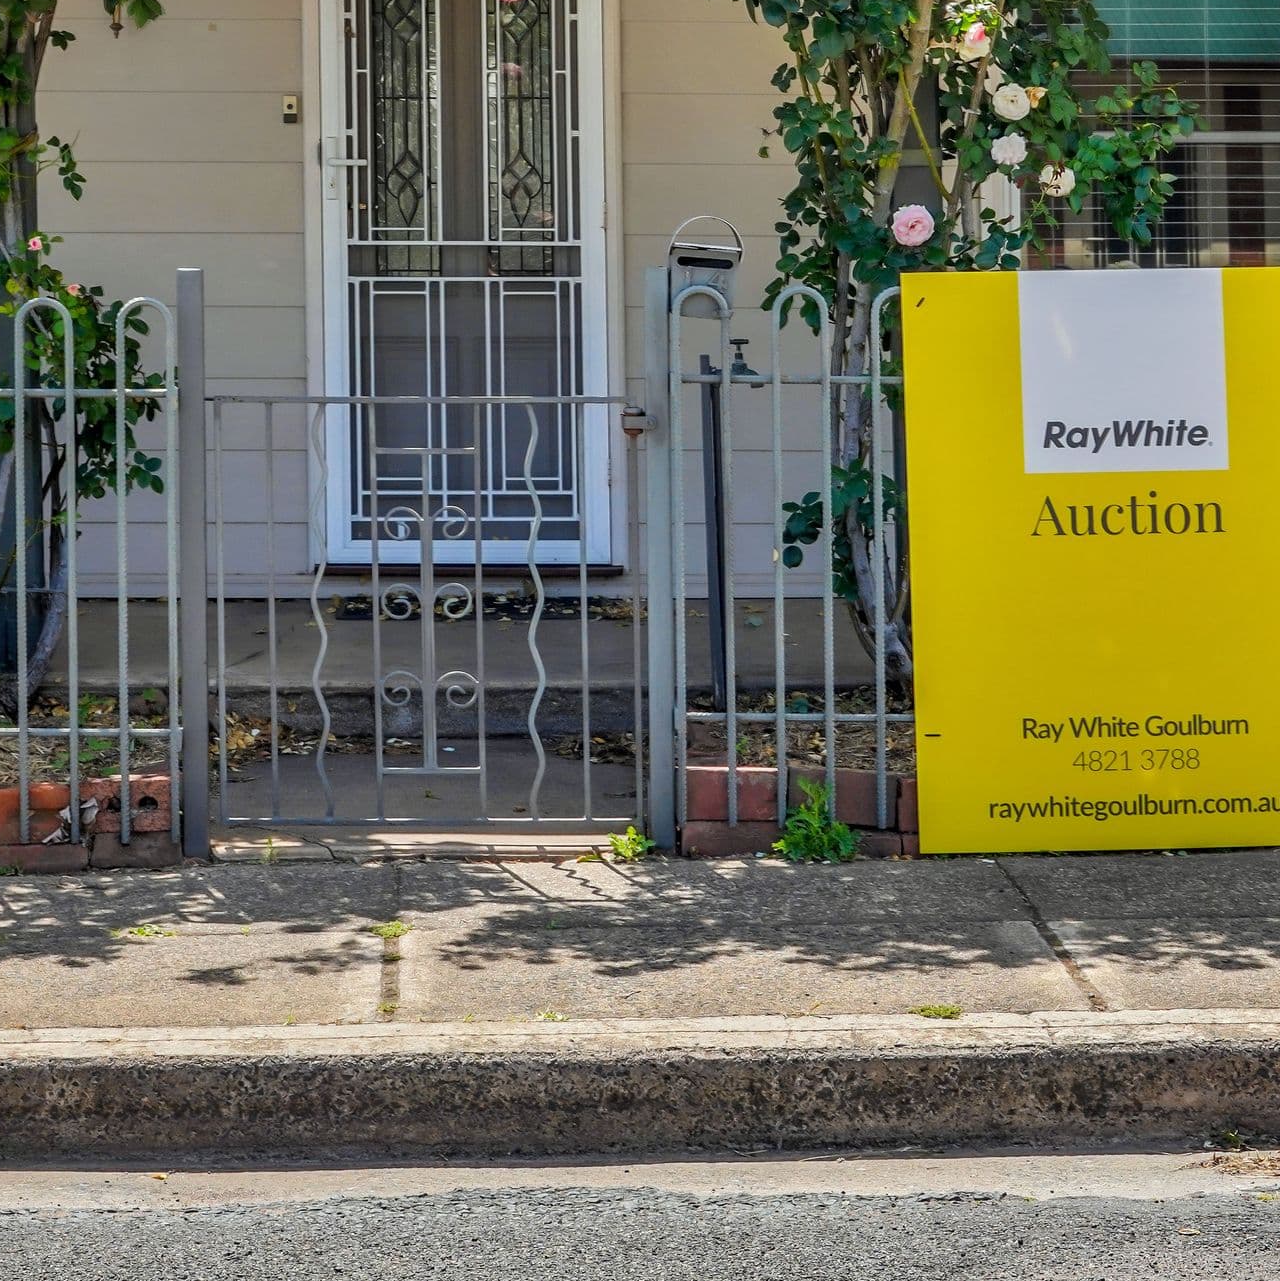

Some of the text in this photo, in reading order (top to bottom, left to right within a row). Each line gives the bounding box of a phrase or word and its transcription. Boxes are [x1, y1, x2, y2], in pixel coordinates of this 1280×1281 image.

[1031, 490, 1227, 537] Auction
[1022, 714, 1249, 743] Ray White Goulburn
[1072, 748, 1201, 772] 4821 3788
